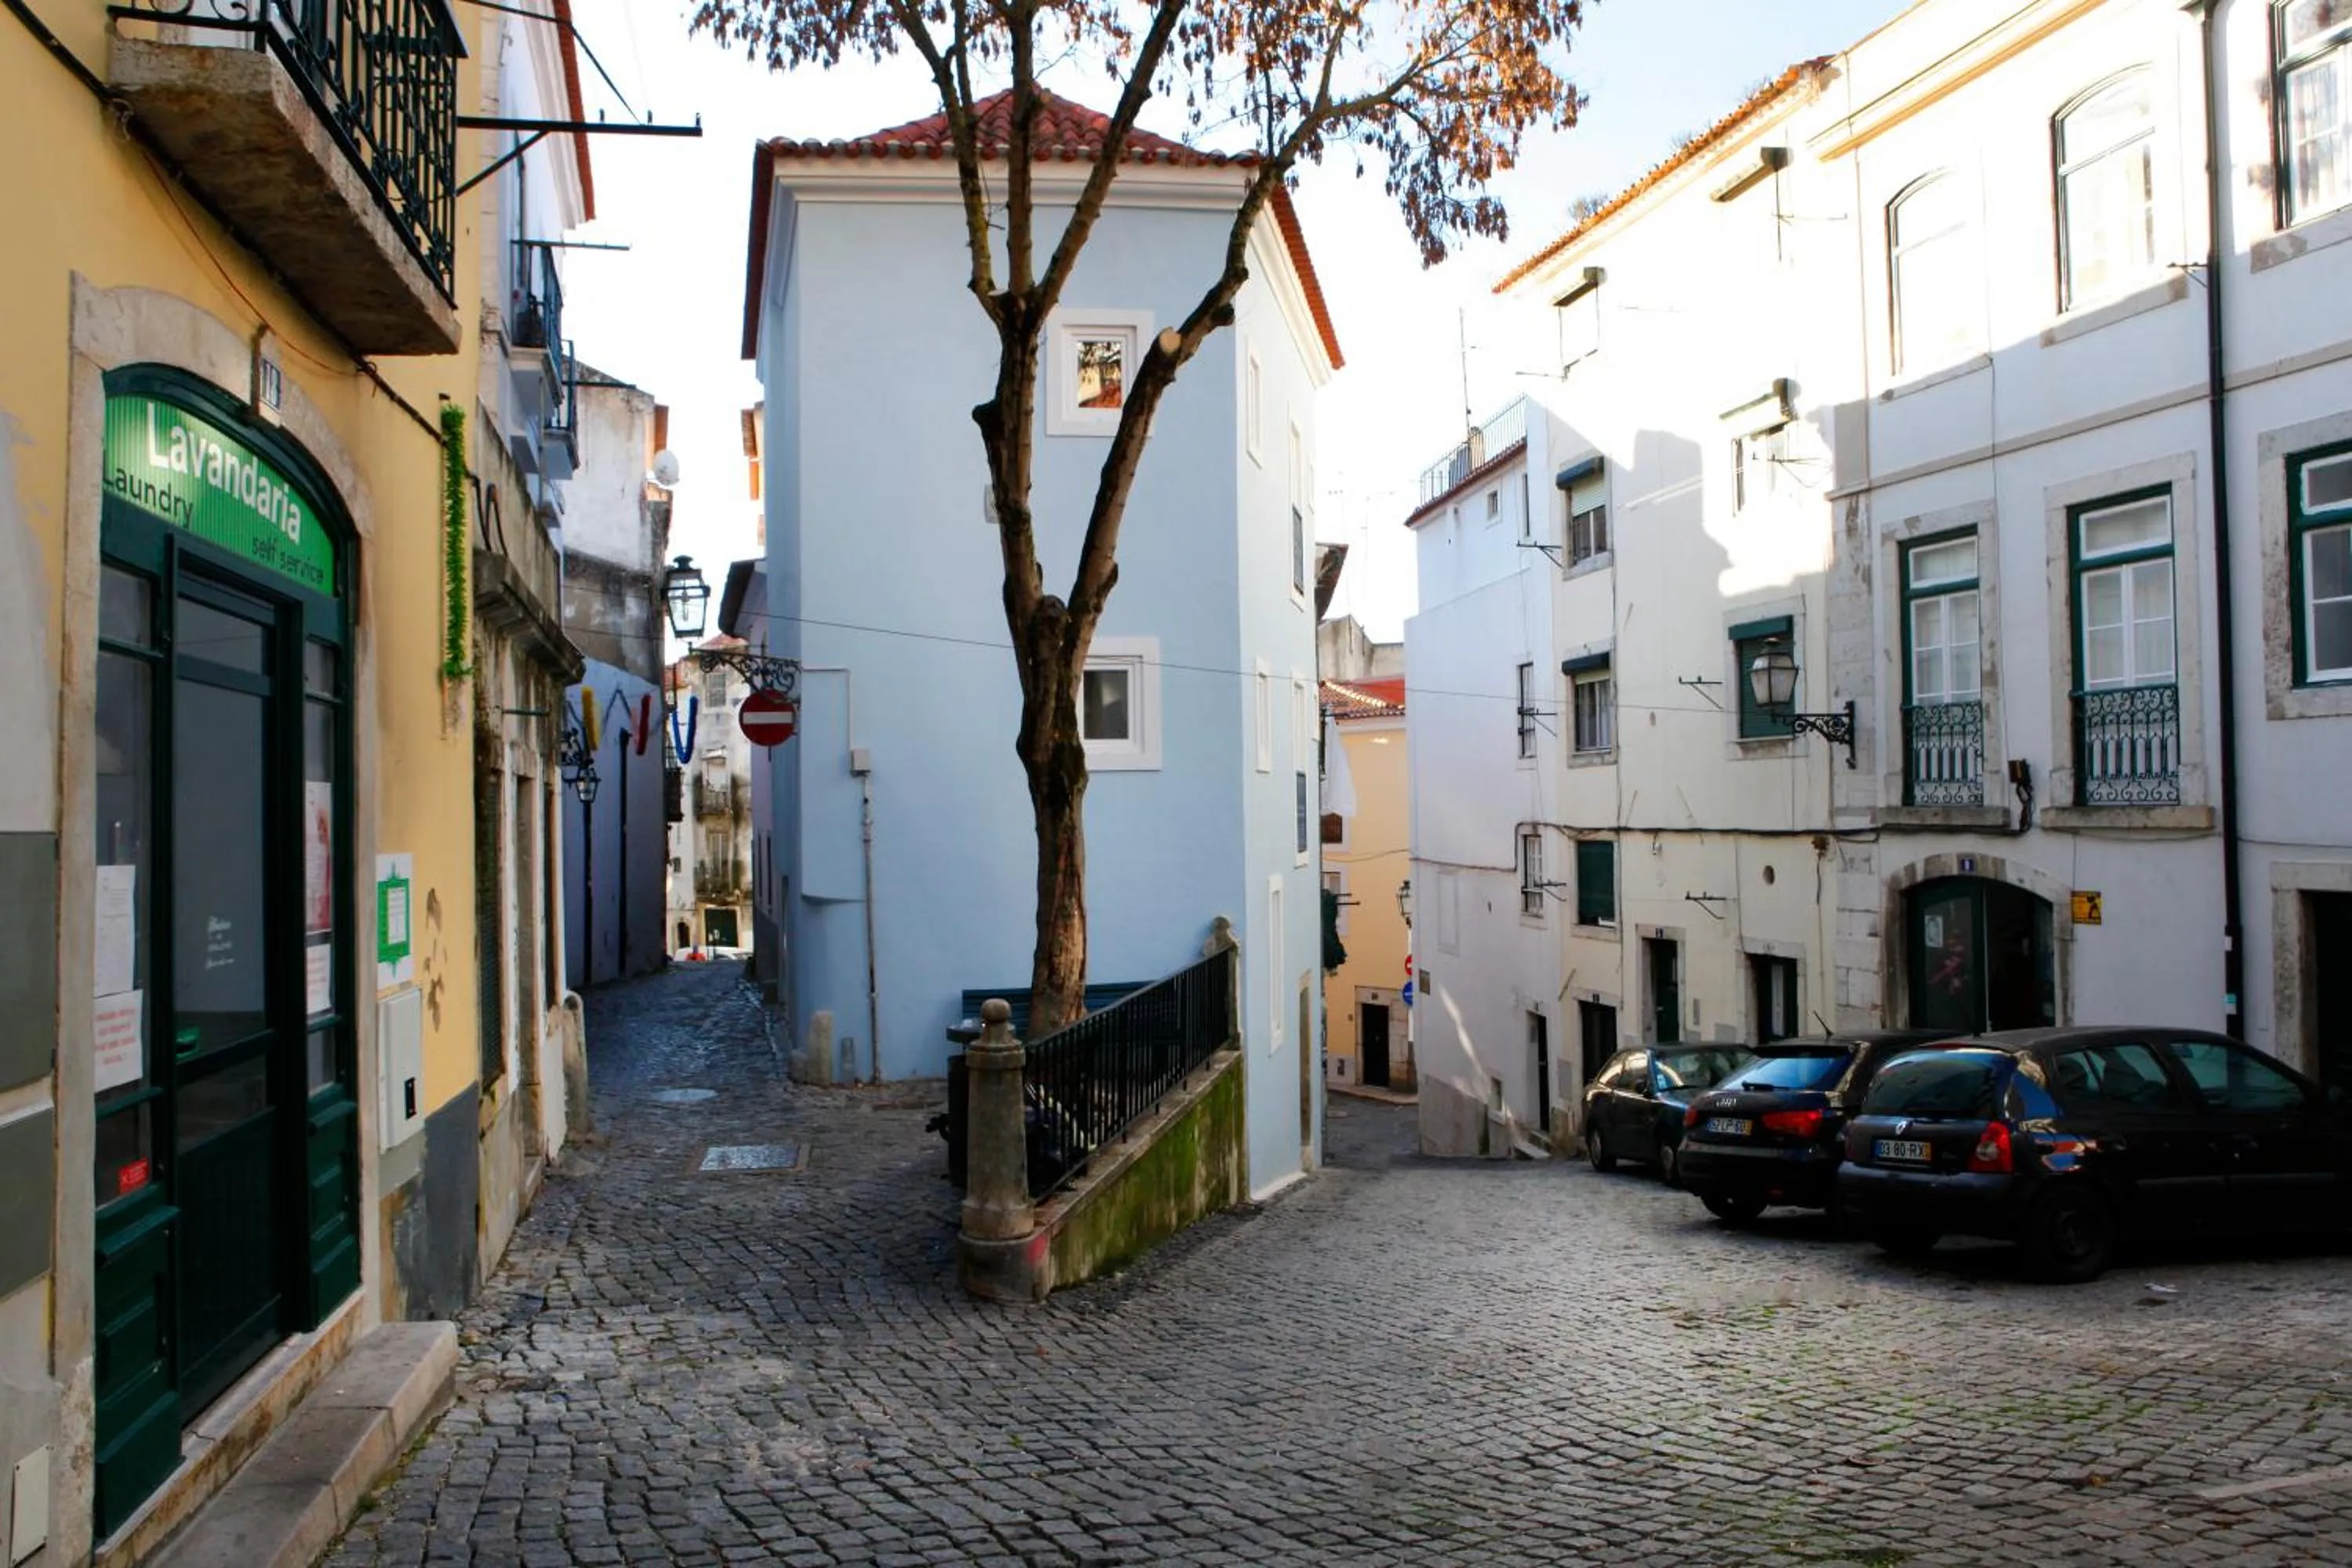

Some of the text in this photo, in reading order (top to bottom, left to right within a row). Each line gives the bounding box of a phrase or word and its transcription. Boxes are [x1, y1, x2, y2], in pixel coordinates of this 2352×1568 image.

[103, 448, 194, 528] Laundry
[147, 401, 302, 544] Lavandaria
[280, 550, 325, 585] service
